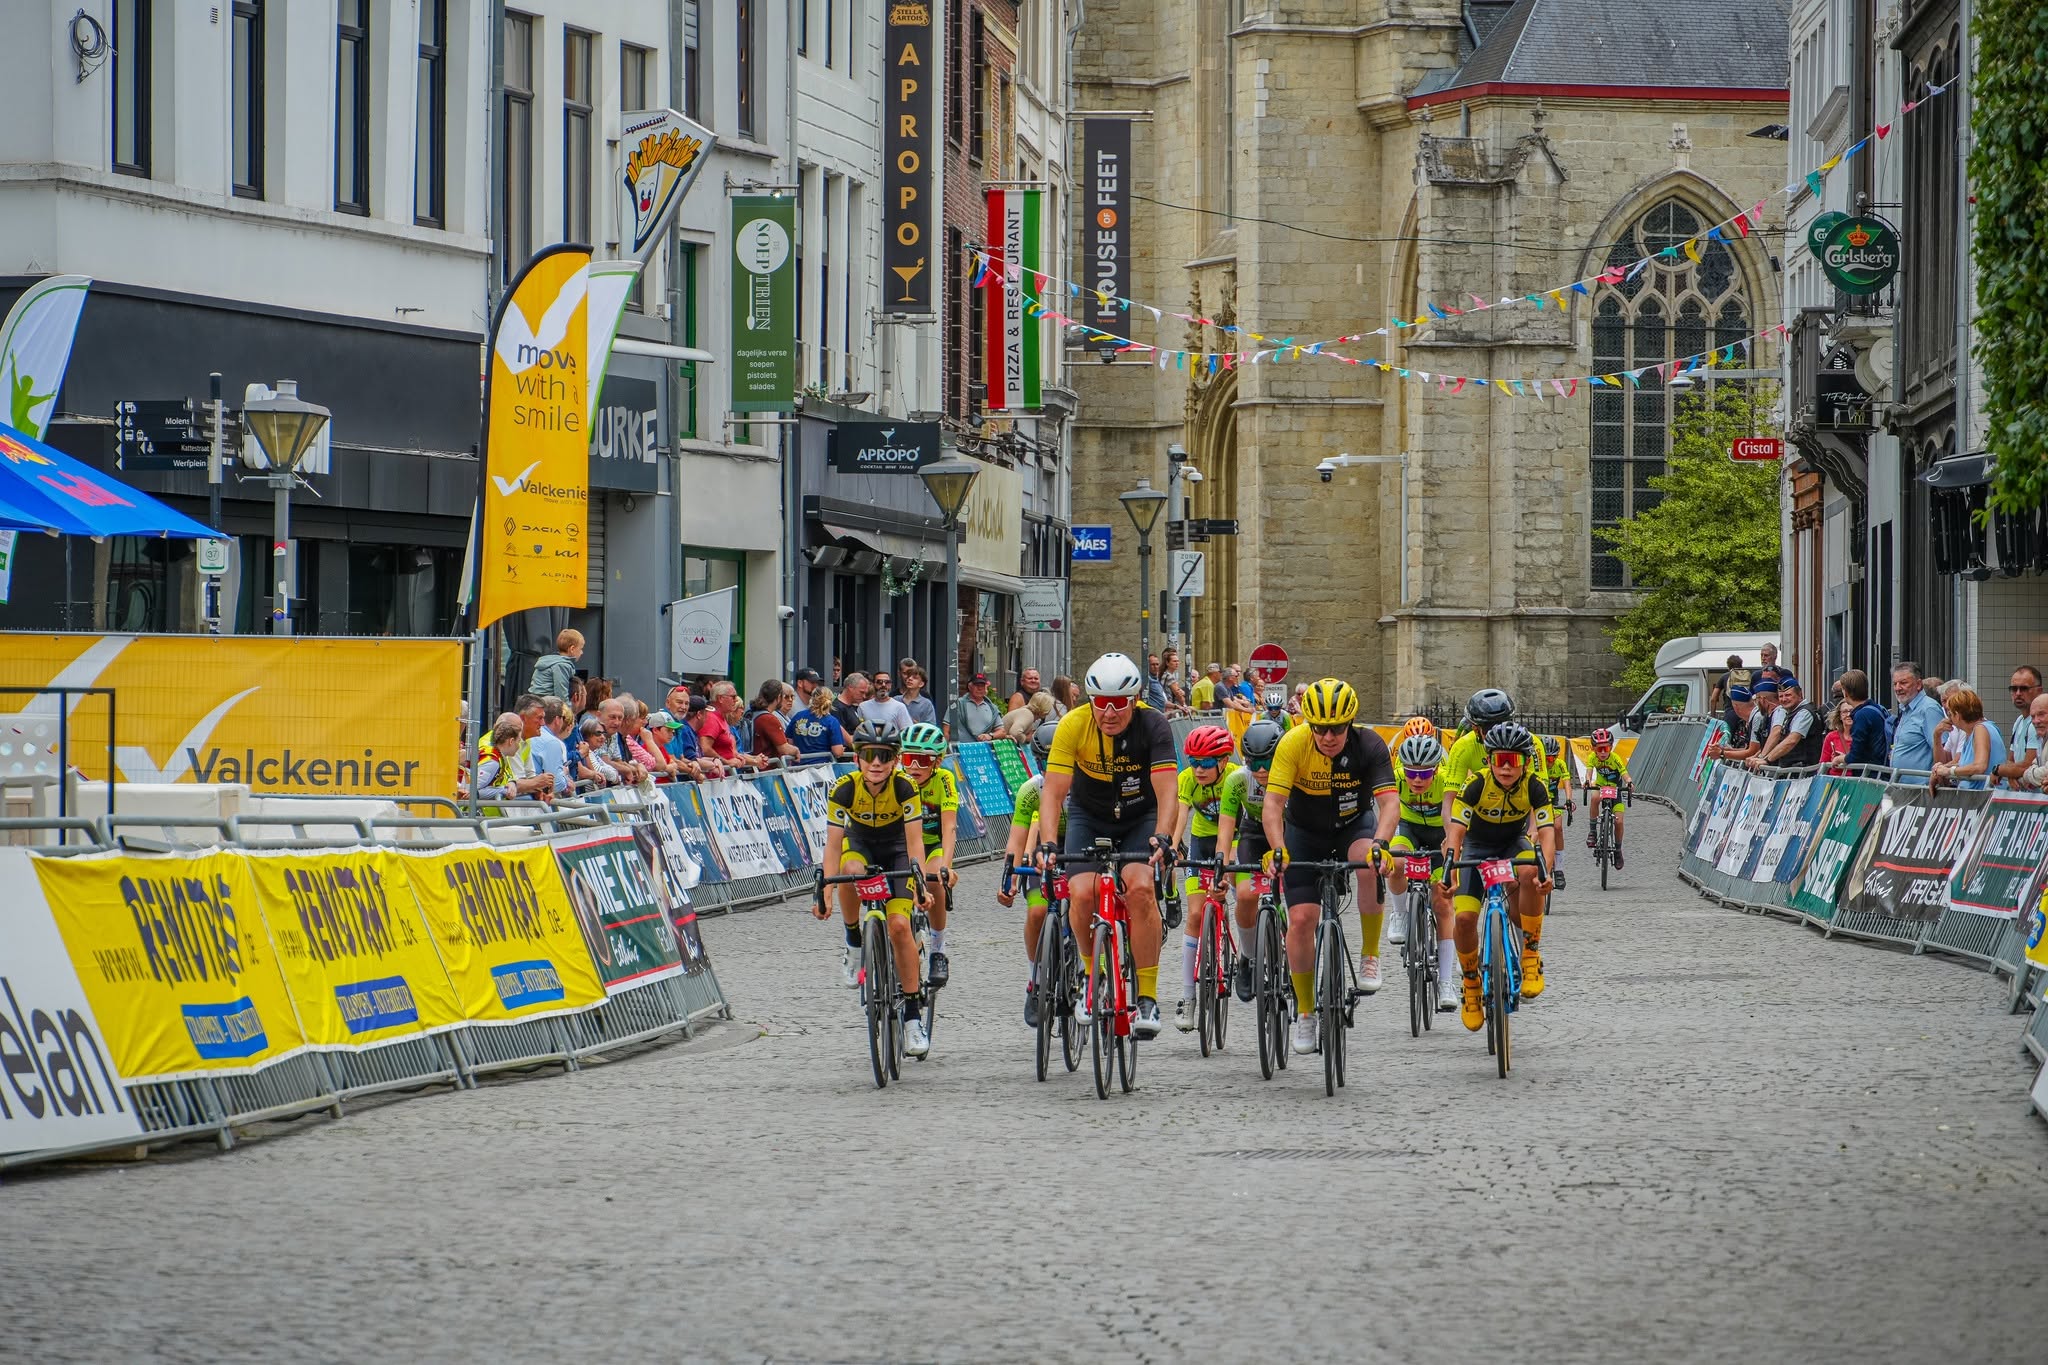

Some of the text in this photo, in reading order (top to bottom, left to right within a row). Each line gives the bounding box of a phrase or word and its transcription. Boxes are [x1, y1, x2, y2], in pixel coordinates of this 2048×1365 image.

[897, 43, 920, 246] APROPO
[1097, 150, 1118, 206] FEET
[1103, 213, 1112, 223] OF
[1825, 245, 1893, 268] Carlsberg
[1097, 230, 1118, 316] HOUSE
[1007, 208, 1020, 392] PIZZA & RESTURANT
[736, 349, 767, 358] dagelijks
[749, 361, 775, 369] soepen
[747, 372, 777, 380] pistolets
[516, 373, 565, 401] with
[749, 383, 775, 391] salades
[165, 417, 190, 425] Molens
[513, 405, 579, 432] smile
[181, 441, 210, 451] Kattestraat
[1738, 441, 1773, 456] Cristal
[173, 459, 206, 468] Werfplein
[1074, 539, 1107, 550] MAES
[207, 550, 218, 558] 37
[541, 571, 578, 580] ALPINE
[186, 747, 419, 787] Valckenier
[1311, 772, 1350, 780] VLAAMSE
[1409, 864, 1427, 873] 104
[861, 884, 883, 894] 108
[0, 976, 125, 1120] elan
